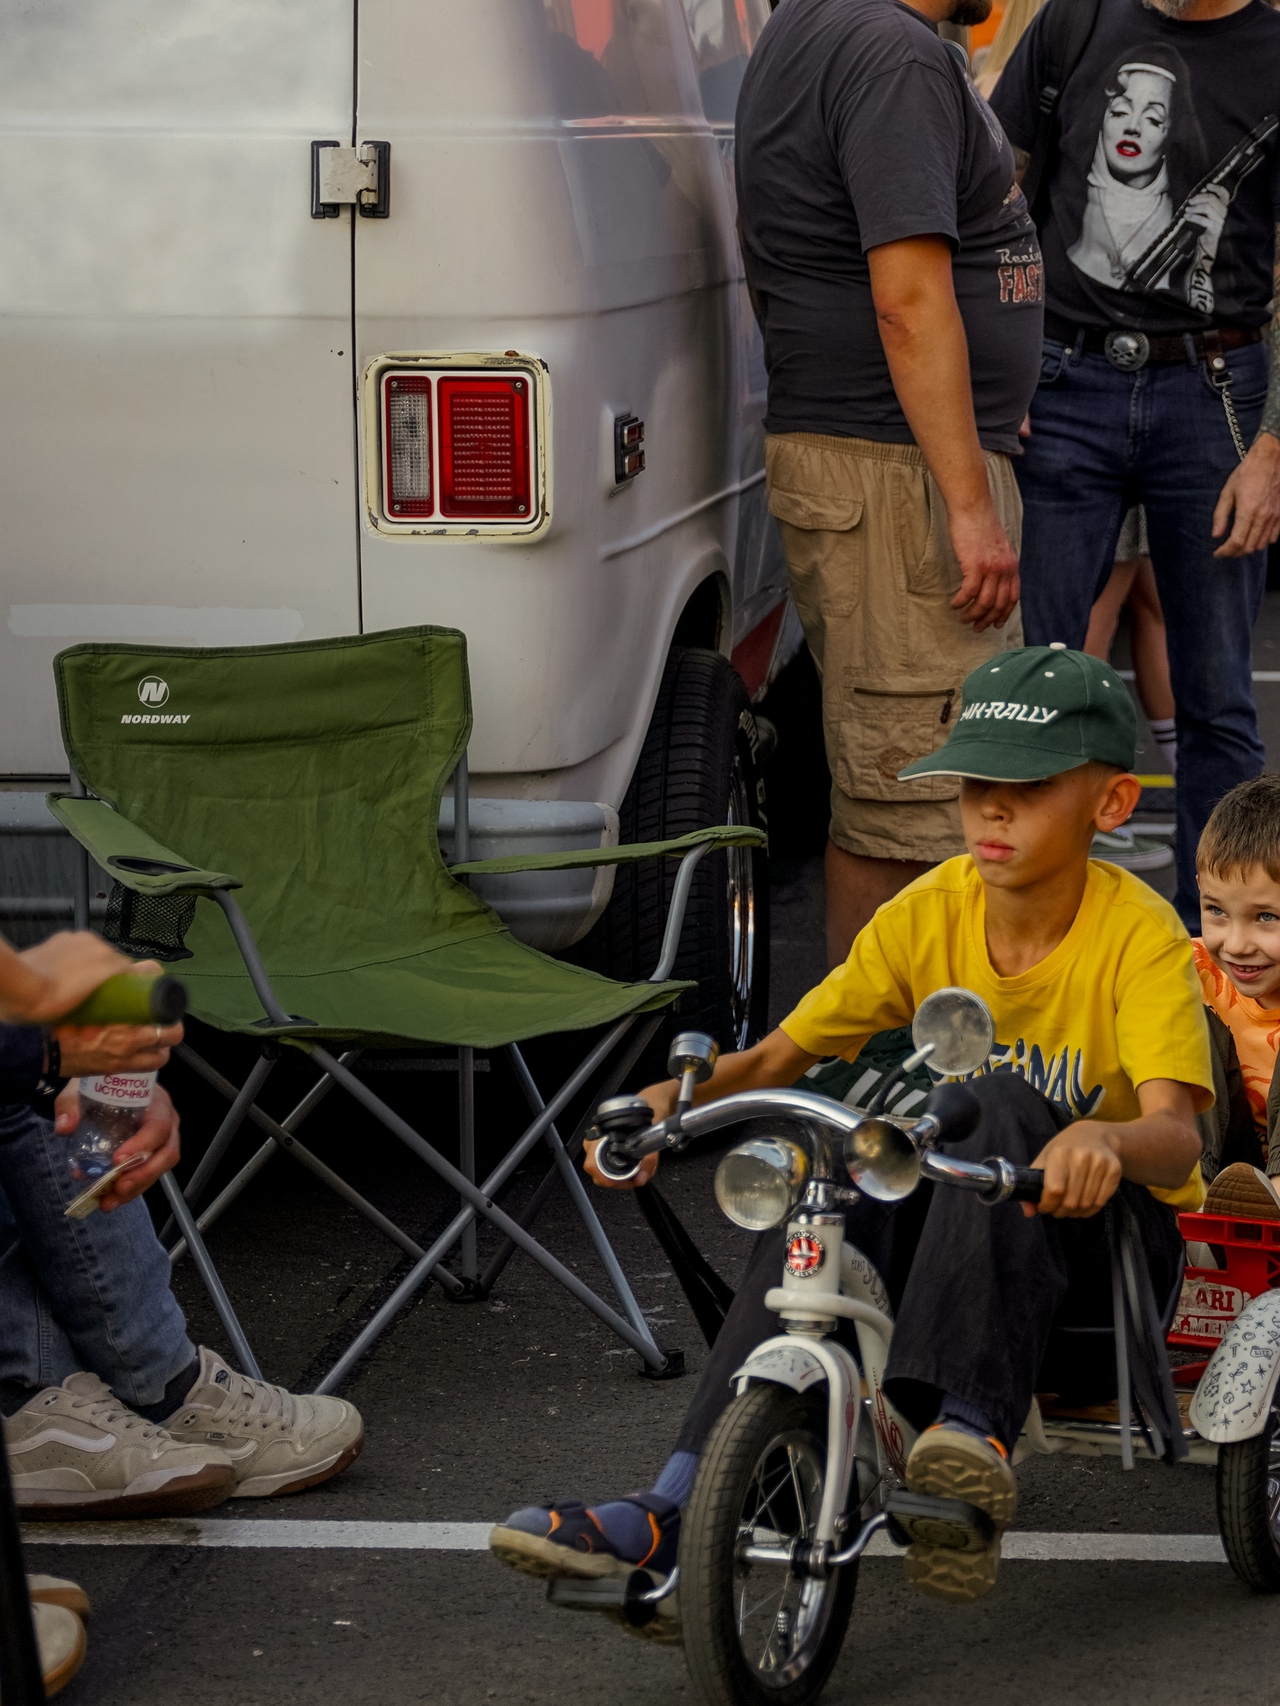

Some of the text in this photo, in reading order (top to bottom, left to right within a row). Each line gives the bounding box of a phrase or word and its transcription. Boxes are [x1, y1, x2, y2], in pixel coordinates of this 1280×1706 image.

[995, 244, 1042, 264] Racin
[120, 714, 191, 724] NORDWAY
[94, 1082, 151, 1099] ИСТОЧНИК
[784, 1261, 820, 1278] QUALITY
